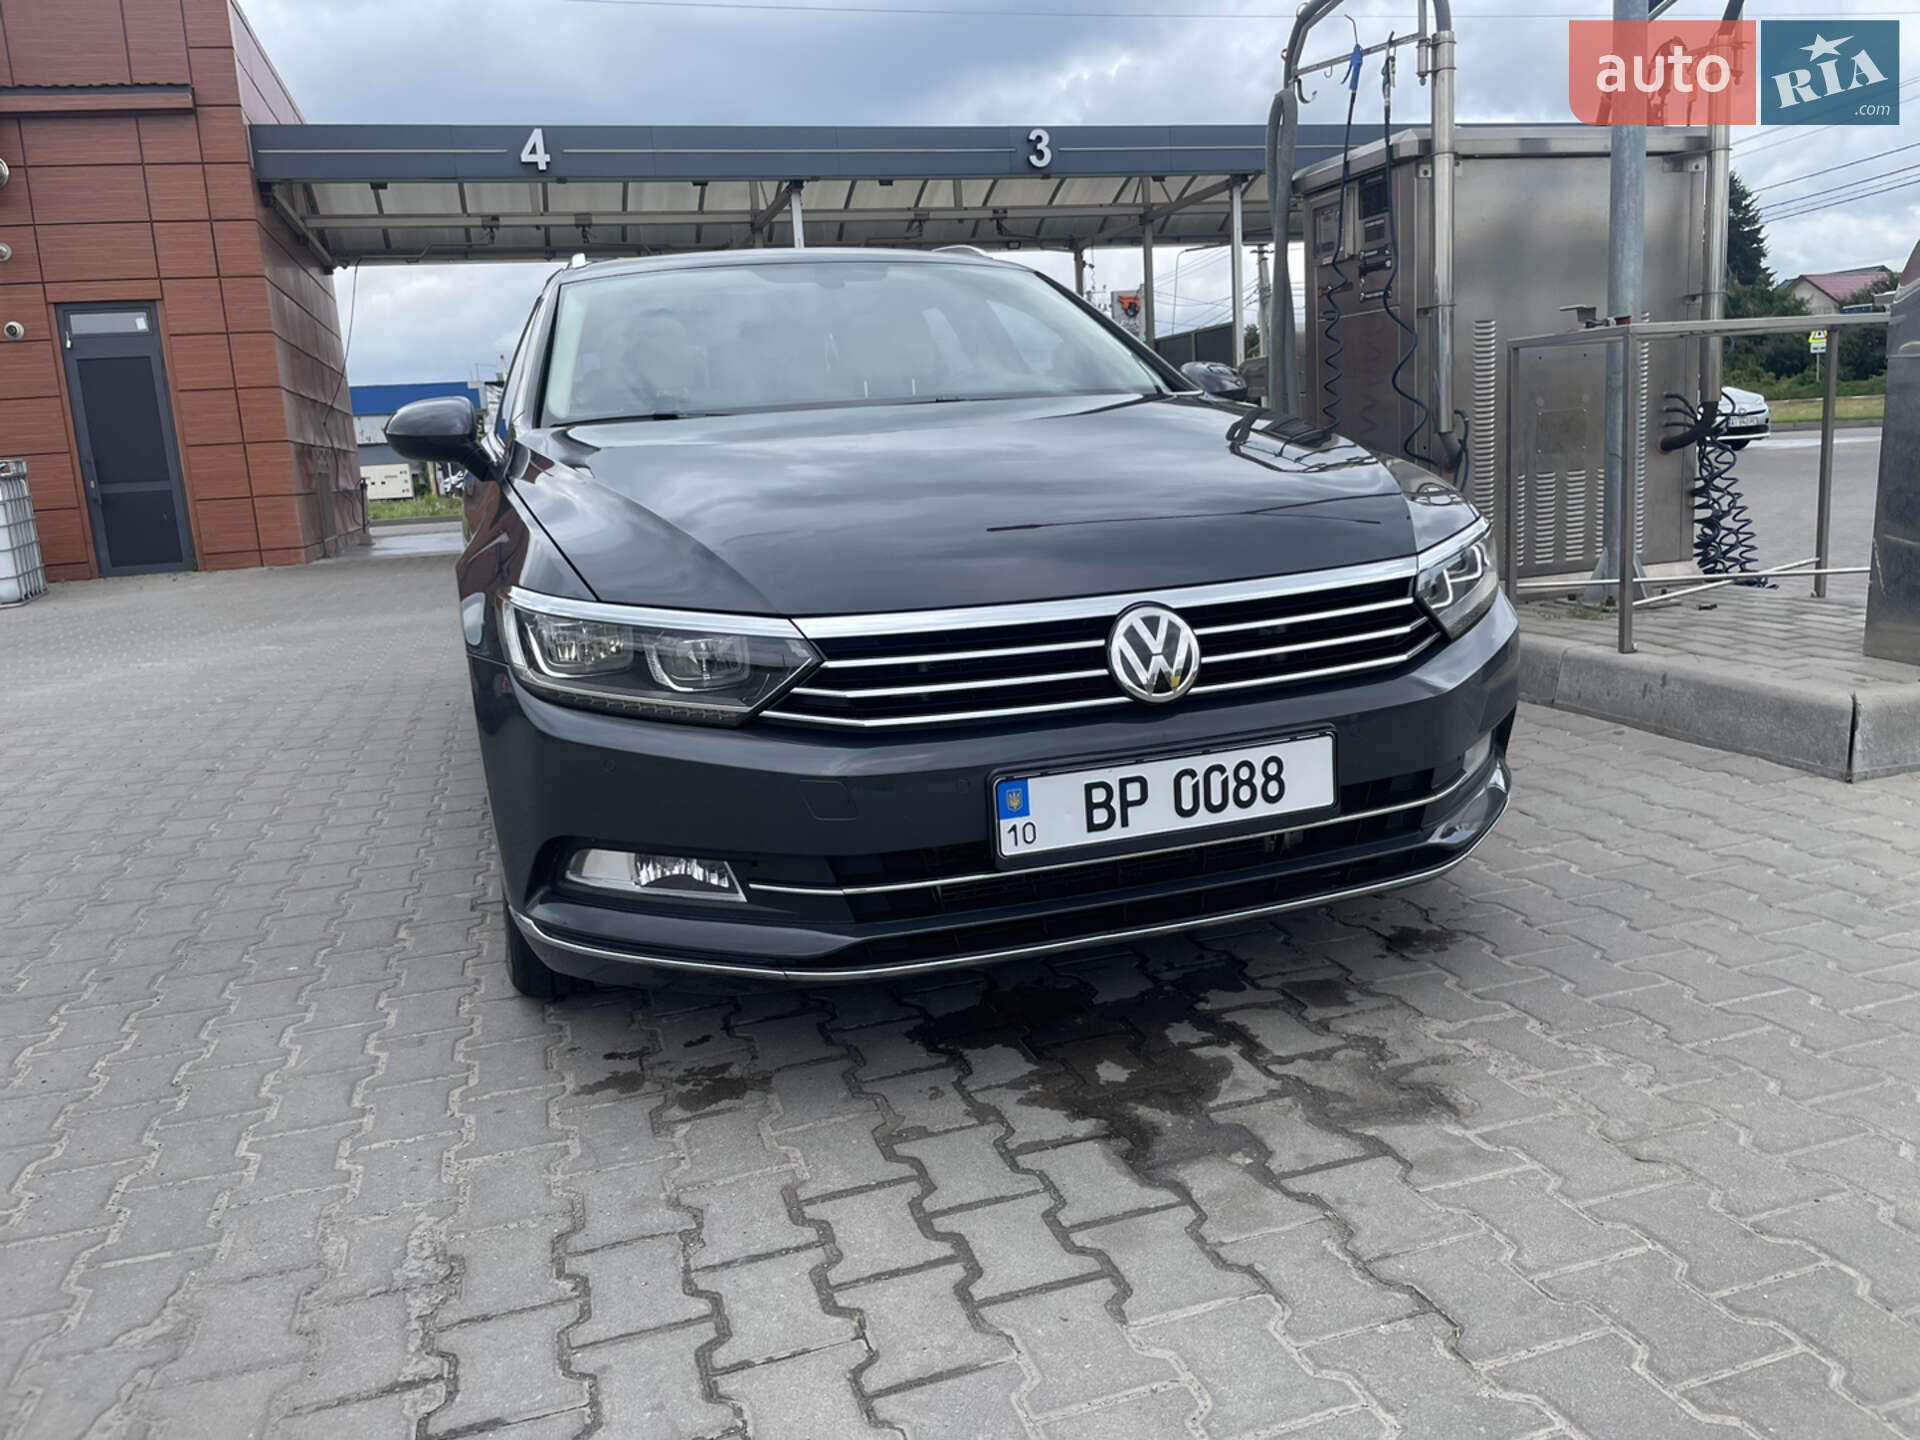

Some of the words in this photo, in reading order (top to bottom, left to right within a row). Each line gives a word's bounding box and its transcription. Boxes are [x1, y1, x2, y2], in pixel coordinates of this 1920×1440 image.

[520, 127, 551, 171] 4
[1028, 128, 1052, 168] 3
[1083, 775, 1149, 834] BP
[1173, 755, 1286, 819] 0088
[1007, 821, 1037, 847] 10
